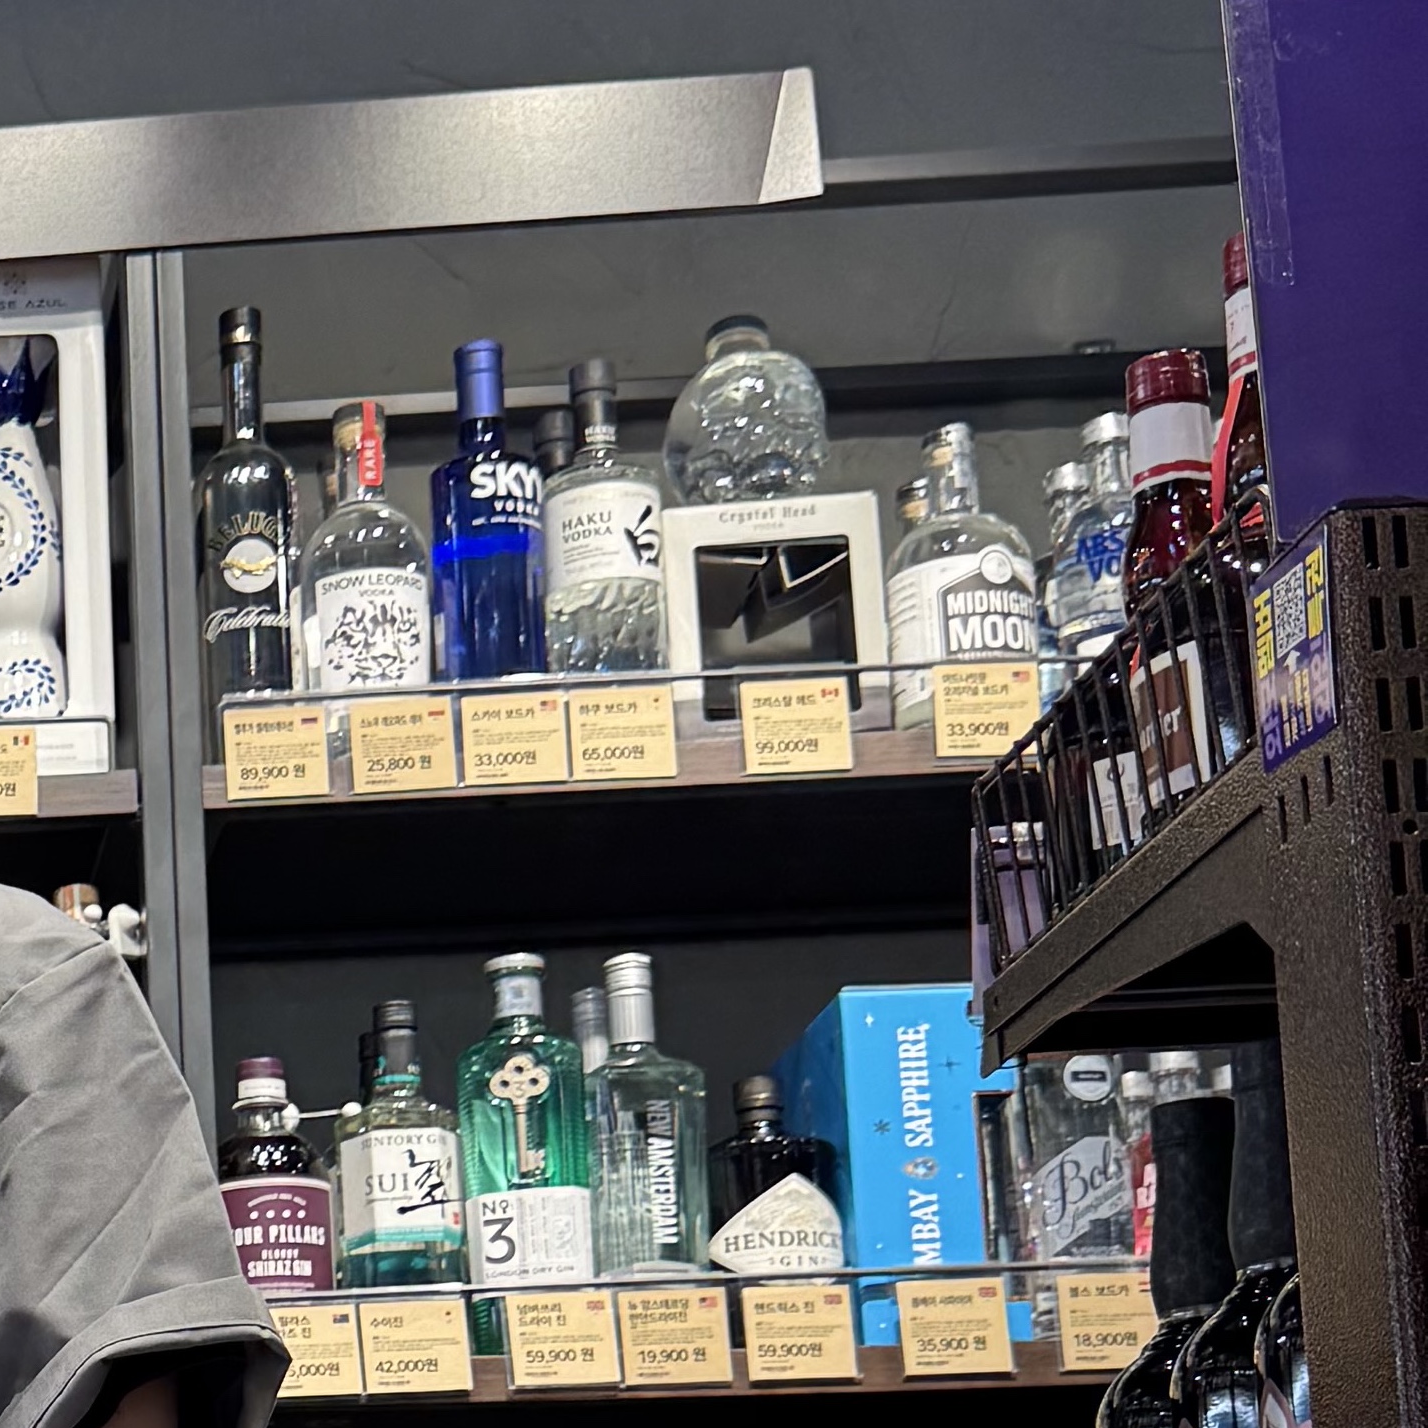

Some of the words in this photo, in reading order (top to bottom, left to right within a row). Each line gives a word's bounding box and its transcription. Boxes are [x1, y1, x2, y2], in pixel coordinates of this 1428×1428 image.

[24, 298, 68, 310] AZUL
[562, 511, 612, 532] HAKU
[719, 507, 776, 524] Crystal
[781, 503, 817, 519] Head
[562, 526, 613, 544] VODKA
[321, 573, 366, 596] SNOW
[367, 572, 423, 592] LEOPARD
[946, 722, 1010, 738] 33,900원
[582, 744, 645, 761] 65,000원
[755, 737, 819, 754] 99,000원
[366, 756, 415, 772] 25,800
[420, 755, 431, 769] 원
[474, 750, 537, 767] 33,000원
[240, 764, 289, 781] 89,900
[293, 764, 305, 779] 원
[896, 1023, 933, 1148] SAPPHIRE
[360, 1132, 424, 1150] SUNTORY
[364, 1171, 412, 1196] SUI
[647, 1135, 679, 1245] AMSTERDAM
[1042, 1139, 1123, 1228] Bols
[268, 1223, 326, 1246] PILLARS
[483, 1218, 517, 1266] 3
[247, 1259, 291, 1278] SHIRAZ
[779, 1254, 817, 1268] GIN
[916, 1336, 968, 1352] 35,900
[973, 1335, 987, 1351] 원
[1073, 1331, 1139, 1348] 18,900원
[525, 1349, 577, 1364] 59,900
[580, 1348, 595, 1363] 원
[757, 1341, 823, 1358] 59,900원
[374, 1356, 439, 1375] 42,000원
